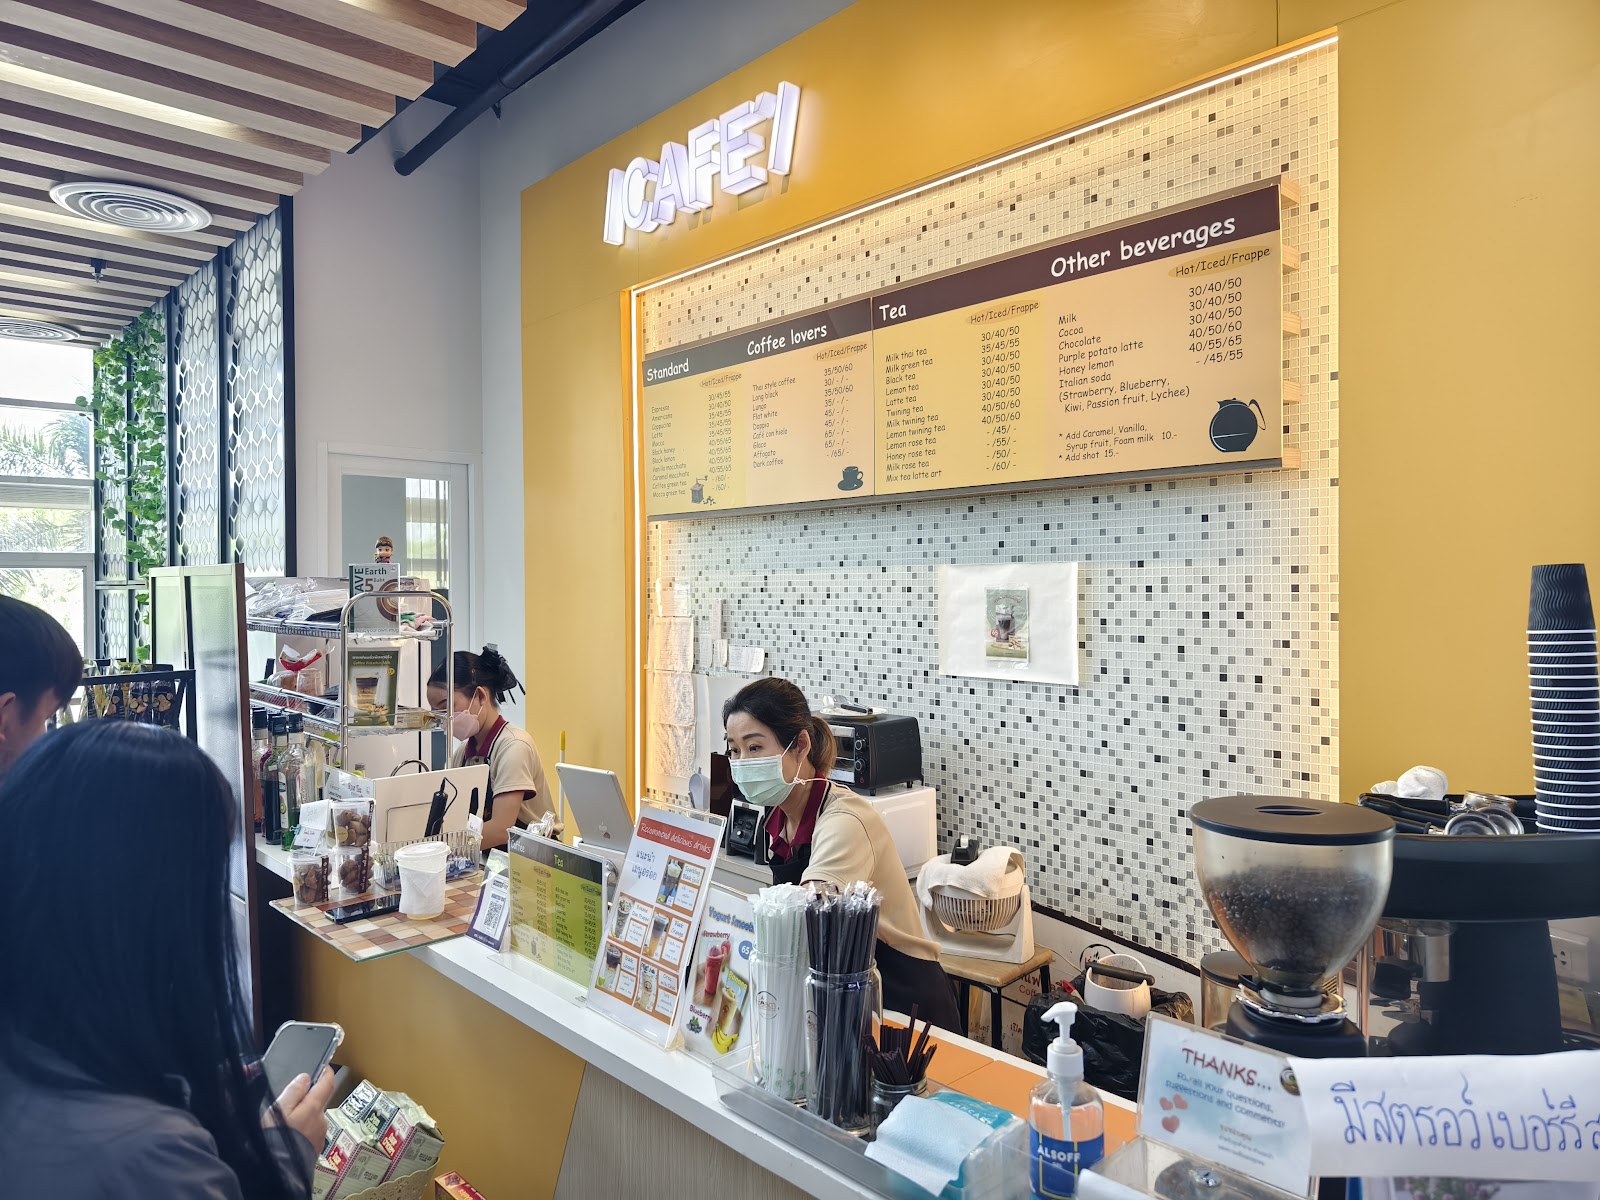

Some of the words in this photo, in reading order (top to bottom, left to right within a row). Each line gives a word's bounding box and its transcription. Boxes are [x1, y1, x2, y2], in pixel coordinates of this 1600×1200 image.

[1051, 250, 1111, 277] Other
[1121, 218, 1235, 260] beverages
[1176, 248, 1271, 277] Hot/Iced/Frappe
[1188, 276, 1242, 298] 30/40/50
[1189, 291, 1242, 312] 30/40/50
[879, 304, 907, 321] Tea
[971, 302, 1039, 324] Hot/Iced/Frappe
[1058, 313, 1077, 325] Milk
[1189, 305, 1242, 326] 30/40/50
[981, 325, 1020, 342] 30/40/50
[1058, 326, 1084, 338] Cocoa
[1188, 320, 1242, 339] 40/50/60
[747, 335, 786, 356] Coffee
[791, 325, 827, 345] lovers
[981, 337, 1020, 354] 35/45/55
[1058, 335, 1102, 351] Chocolate
[1188, 334, 1242, 353] 40/55/65
[885, 353, 900, 363] Milk
[900, 349, 914, 360] thai
[916, 348, 927, 356] tea
[981, 349, 1021, 366] 30/40/50
[1058, 350, 1086, 364] Purple
[1088, 345, 1118, 361] potato
[1120, 340, 1144, 352] latte
[647, 358, 689, 382] Standard
[823, 362, 853, 377] 35/50/60
[885, 363, 900, 374] Milk
[900, 361, 920, 374] green
[921, 358, 933, 366] tea
[981, 362, 1021, 378] 30/40/50
[1059, 365, 1086, 376] Honey
[1088, 359, 1115, 371] lemon
[885, 374, 904, 385] Black
[904, 373, 916, 381] tea
[981, 374, 1021, 390] 30/40/50
[1059, 376, 1088, 389] Italian
[1090, 371, 1111, 384] soda
[824, 383, 854, 397] 35/50/60
[885, 386, 907, 396] Lemon
[908, 384, 919, 392] tea
[981, 386, 1021, 402] 30/40/50
[1059, 386, 1117, 403] (Strawberry,
[1119, 378, 1170, 392] Blueberry,
[885, 398, 904, 407] Latte
[905, 395, 917, 403] tea
[981, 398, 1021, 413] 40/50/60
[1064, 401, 1085, 413] Kiwi,
[1086, 397, 1120, 410] Passion
[1122, 393, 1148, 405] fruit,
[886, 408, 911, 417] Twining
[912, 405, 924, 413] tea
[981, 411, 1021, 425] 40/50/60
[886, 419, 901, 428] Milk
[901, 415, 926, 426] twining
[927, 414, 939, 422] tea
[886, 430, 907, 440] Lemon
[908, 426, 932, 436] twining
[934, 424, 946, 432] tea
[1065, 430, 1081, 440] Add
[1082, 426, 1116, 438] Caramel,
[1118, 423, 1147, 434] Vanilla,
[886, 441, 907, 451] Lemon
[908, 439, 924, 447] rose
[924, 437, 937, 445] tea
[1065, 442, 1088, 453] Syrup
[1090, 438, 1112, 449] fruit,
[1113, 436, 1135, 446] Foam
[1137, 433, 1154, 443] milk
[886, 452, 907, 461] Honey
[907, 450, 923, 458] rose
[924, 448, 936, 456] tea
[1065, 452, 1081, 462] Add
[1082, 451, 1100, 460] shot
[886, 463, 900, 471] Milk
[901, 462, 917, 470] rose
[918, 460, 930, 468] tea
[886, 474, 899, 482] Mix
[900, 473, 911, 481] tea
[912, 471, 929, 480] latte
[930, 469, 942, 478] art
[365, 567, 387, 575] Earth
[354, 567, 364, 595] AVE
[365, 578, 374, 592] 5
[510, 839, 525, 853] Coffee
[553, 854, 564, 868] Tea
[709, 906, 731, 924] Yogurt
[741, 945, 750, 955] 65
[728, 970, 748, 990] Banana
[689, 1004, 713, 1023] Blueberry
[1182, 1047, 1271, 1091] THANKS...
[1204, 1081, 1224, 1094] your
[1216, 1099, 1233, 1111] and
[1037, 1144, 1080, 1163] ALSOFF
